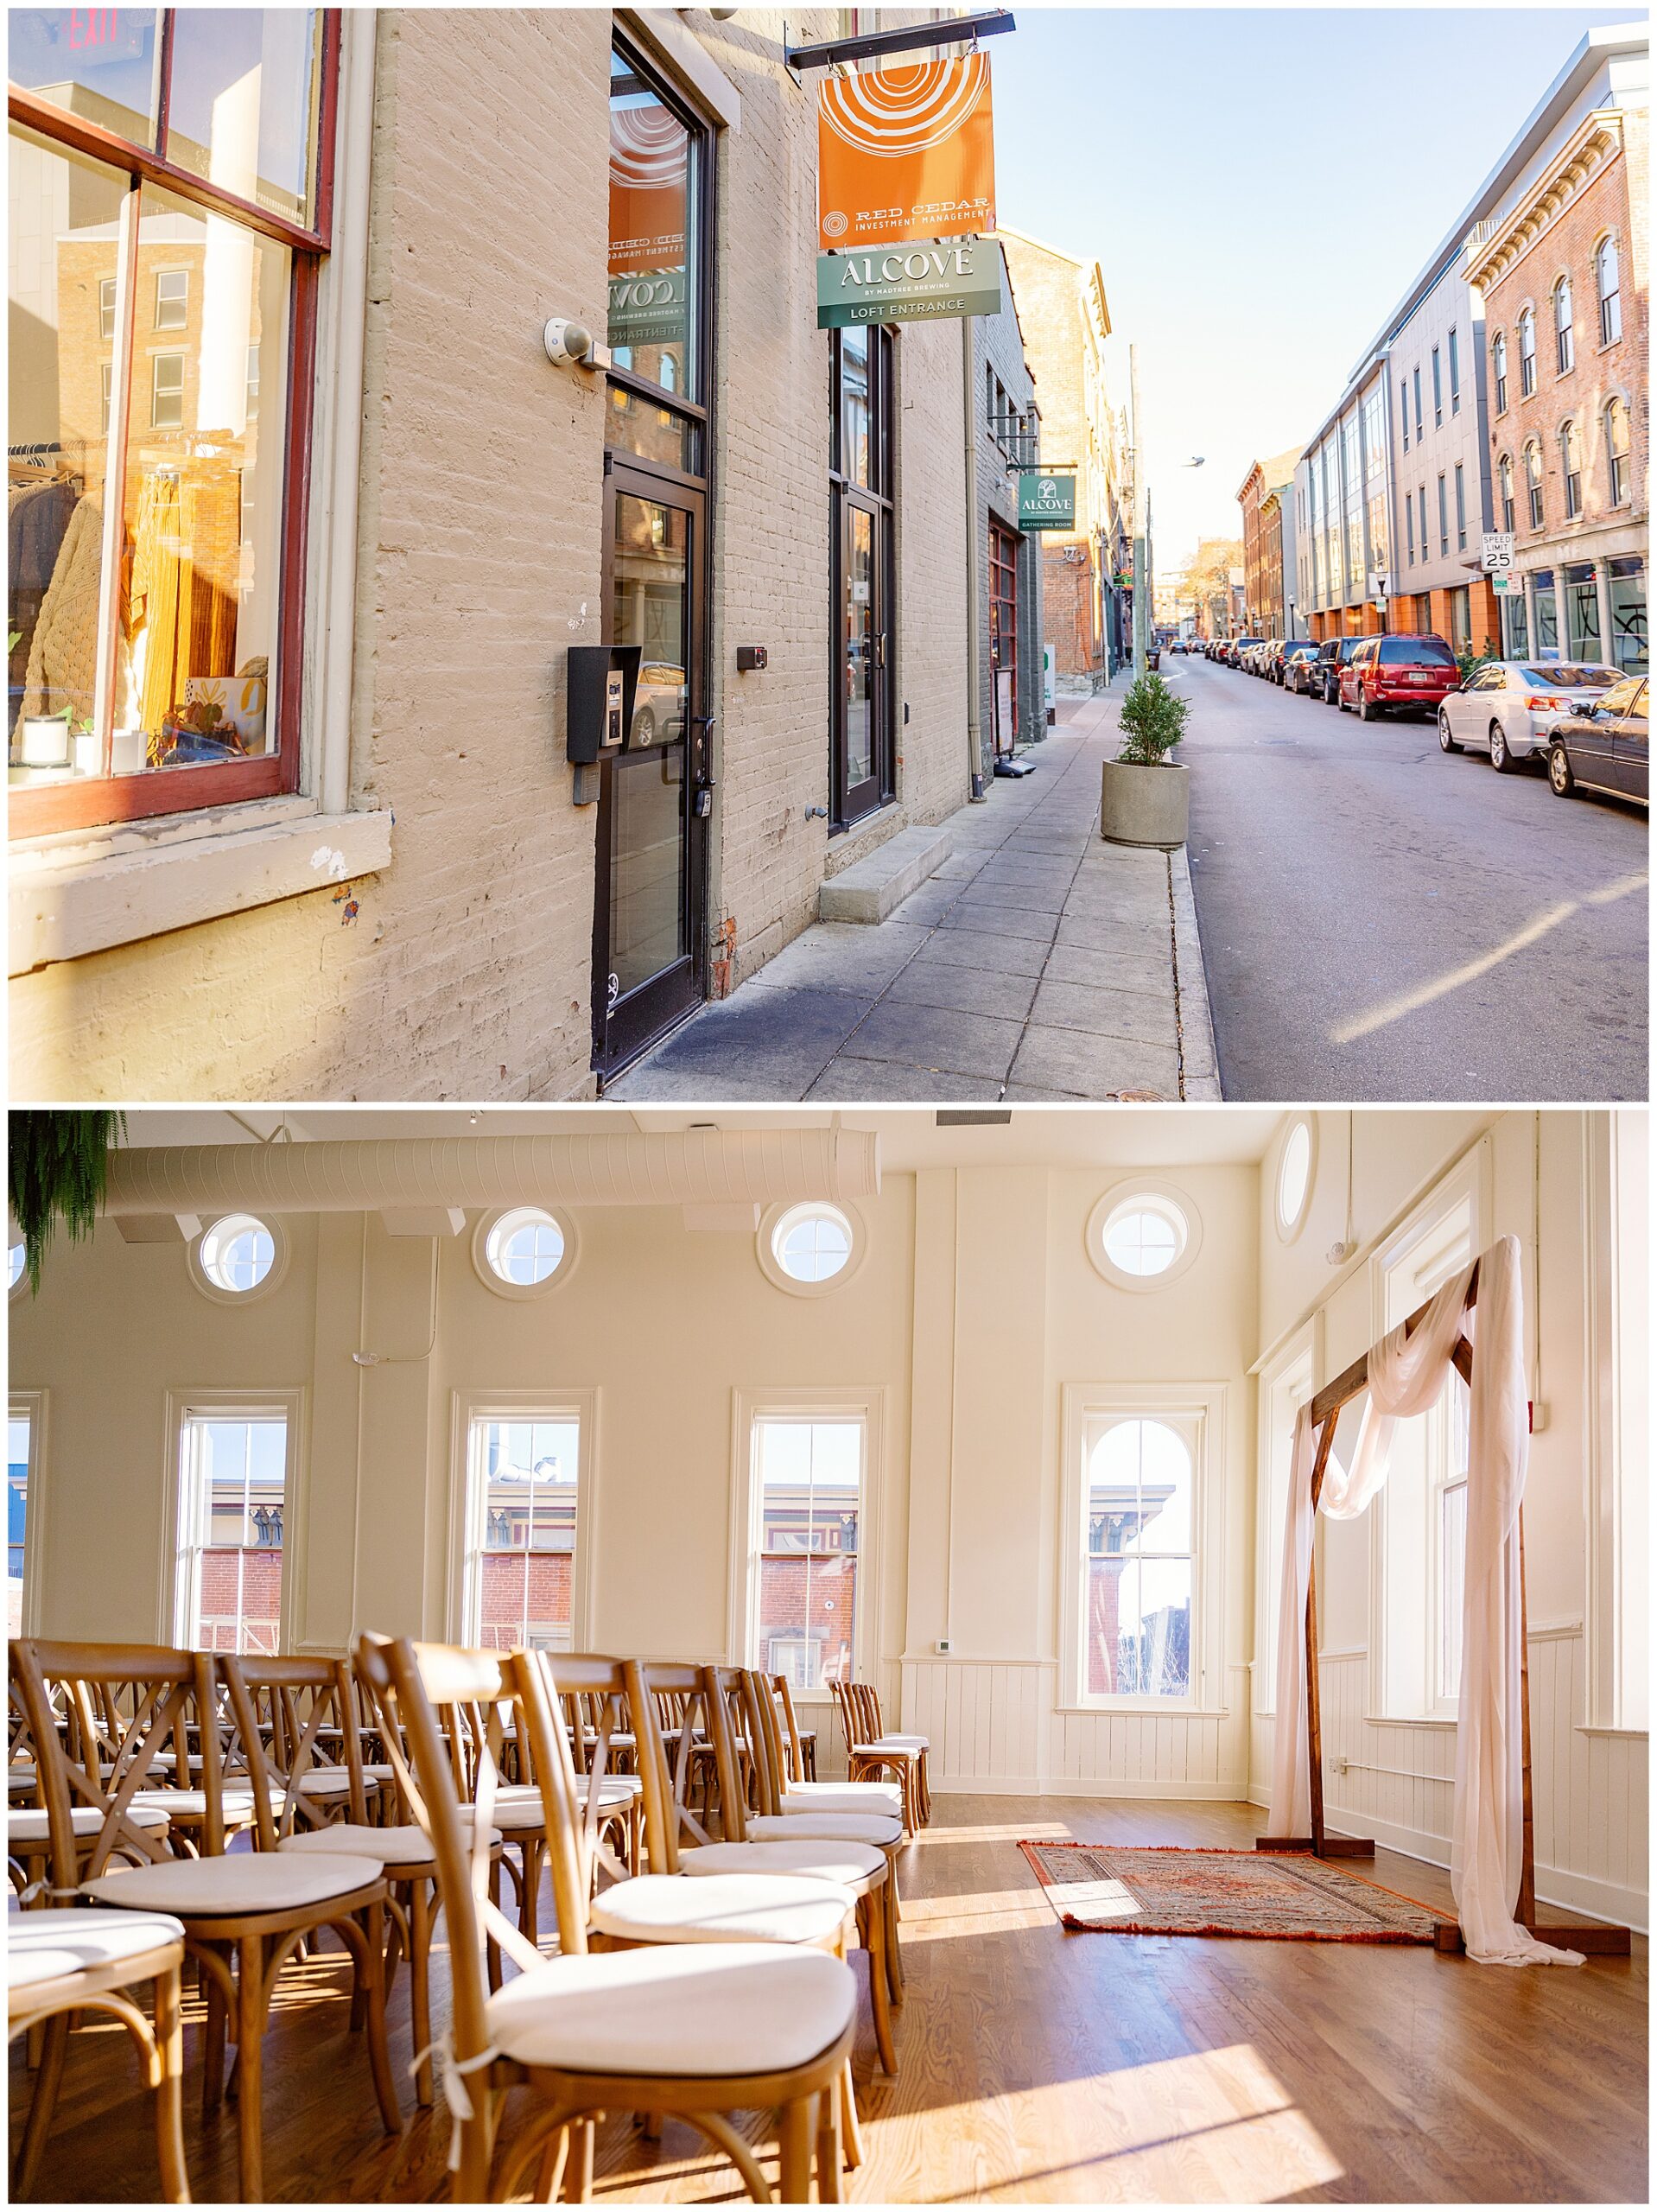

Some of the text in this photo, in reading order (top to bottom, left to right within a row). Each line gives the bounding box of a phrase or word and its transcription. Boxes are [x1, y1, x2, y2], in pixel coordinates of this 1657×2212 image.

[855, 197, 990, 221] RED CEDAR
[855, 209, 990, 232] INVESTMENT MANAGEMENT
[841, 247, 974, 287] ALCOVE
[877, 286, 911, 295] MADTREE
[914, 283, 950, 291] BREWING
[850, 299, 966, 319] LOFT ENTRANCE
[1022, 499, 1072, 510] ALCOVE
[1486, 553, 1510, 566] 25
